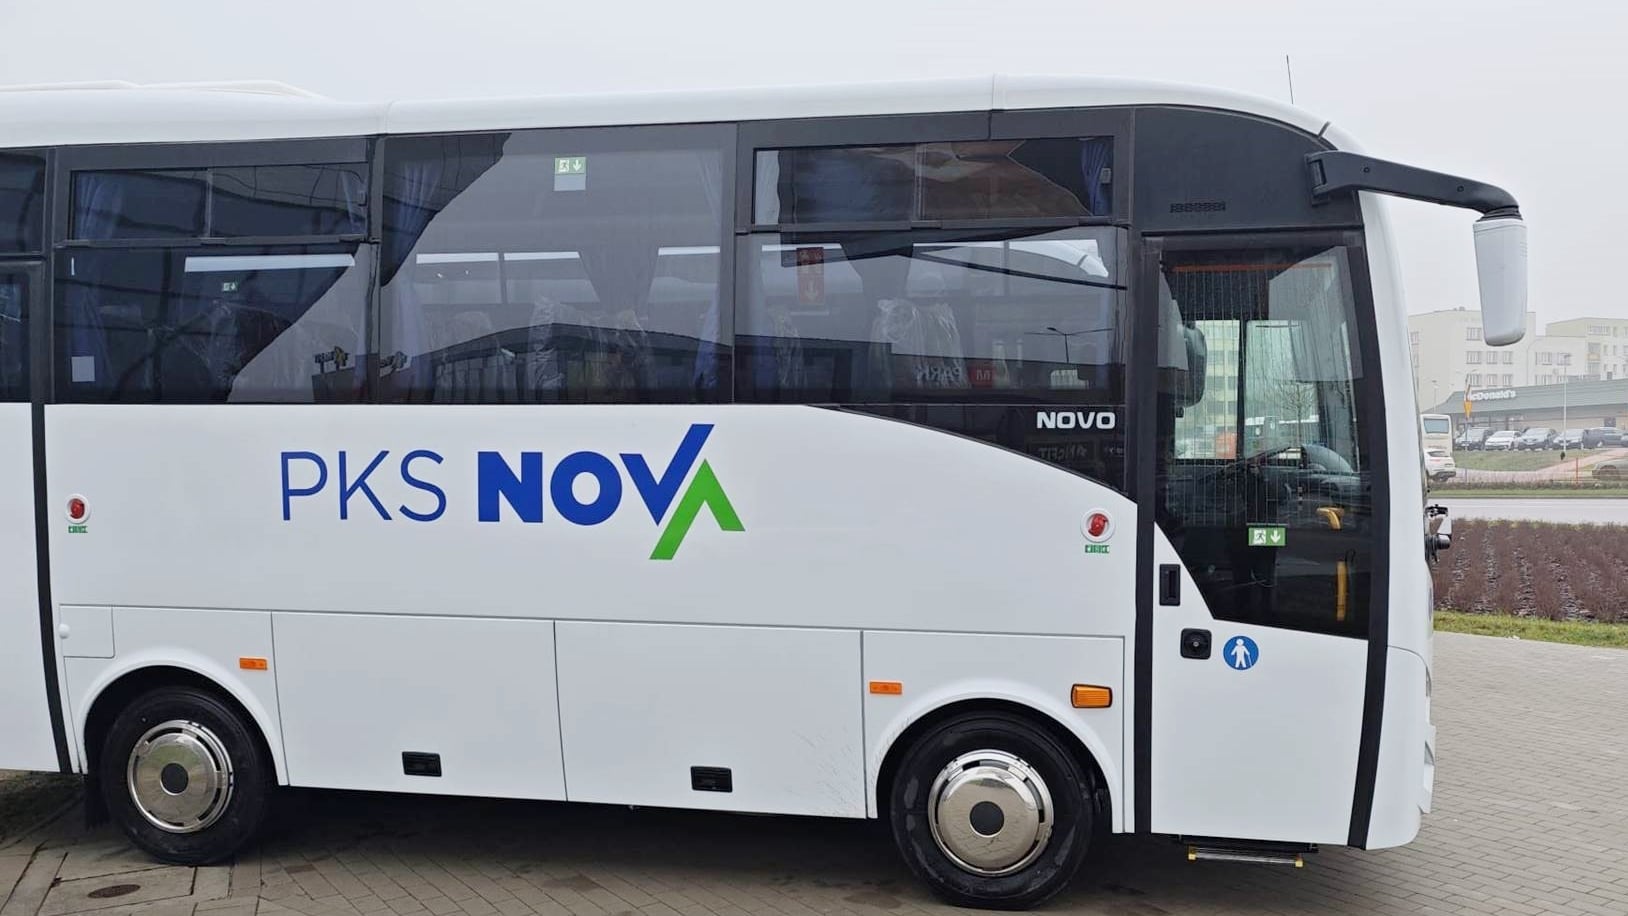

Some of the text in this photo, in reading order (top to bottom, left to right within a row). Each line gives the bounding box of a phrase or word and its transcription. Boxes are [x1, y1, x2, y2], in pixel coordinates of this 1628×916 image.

[1036, 411, 1116, 429] NOVO
[281, 424, 746, 560] PKS NOVA
